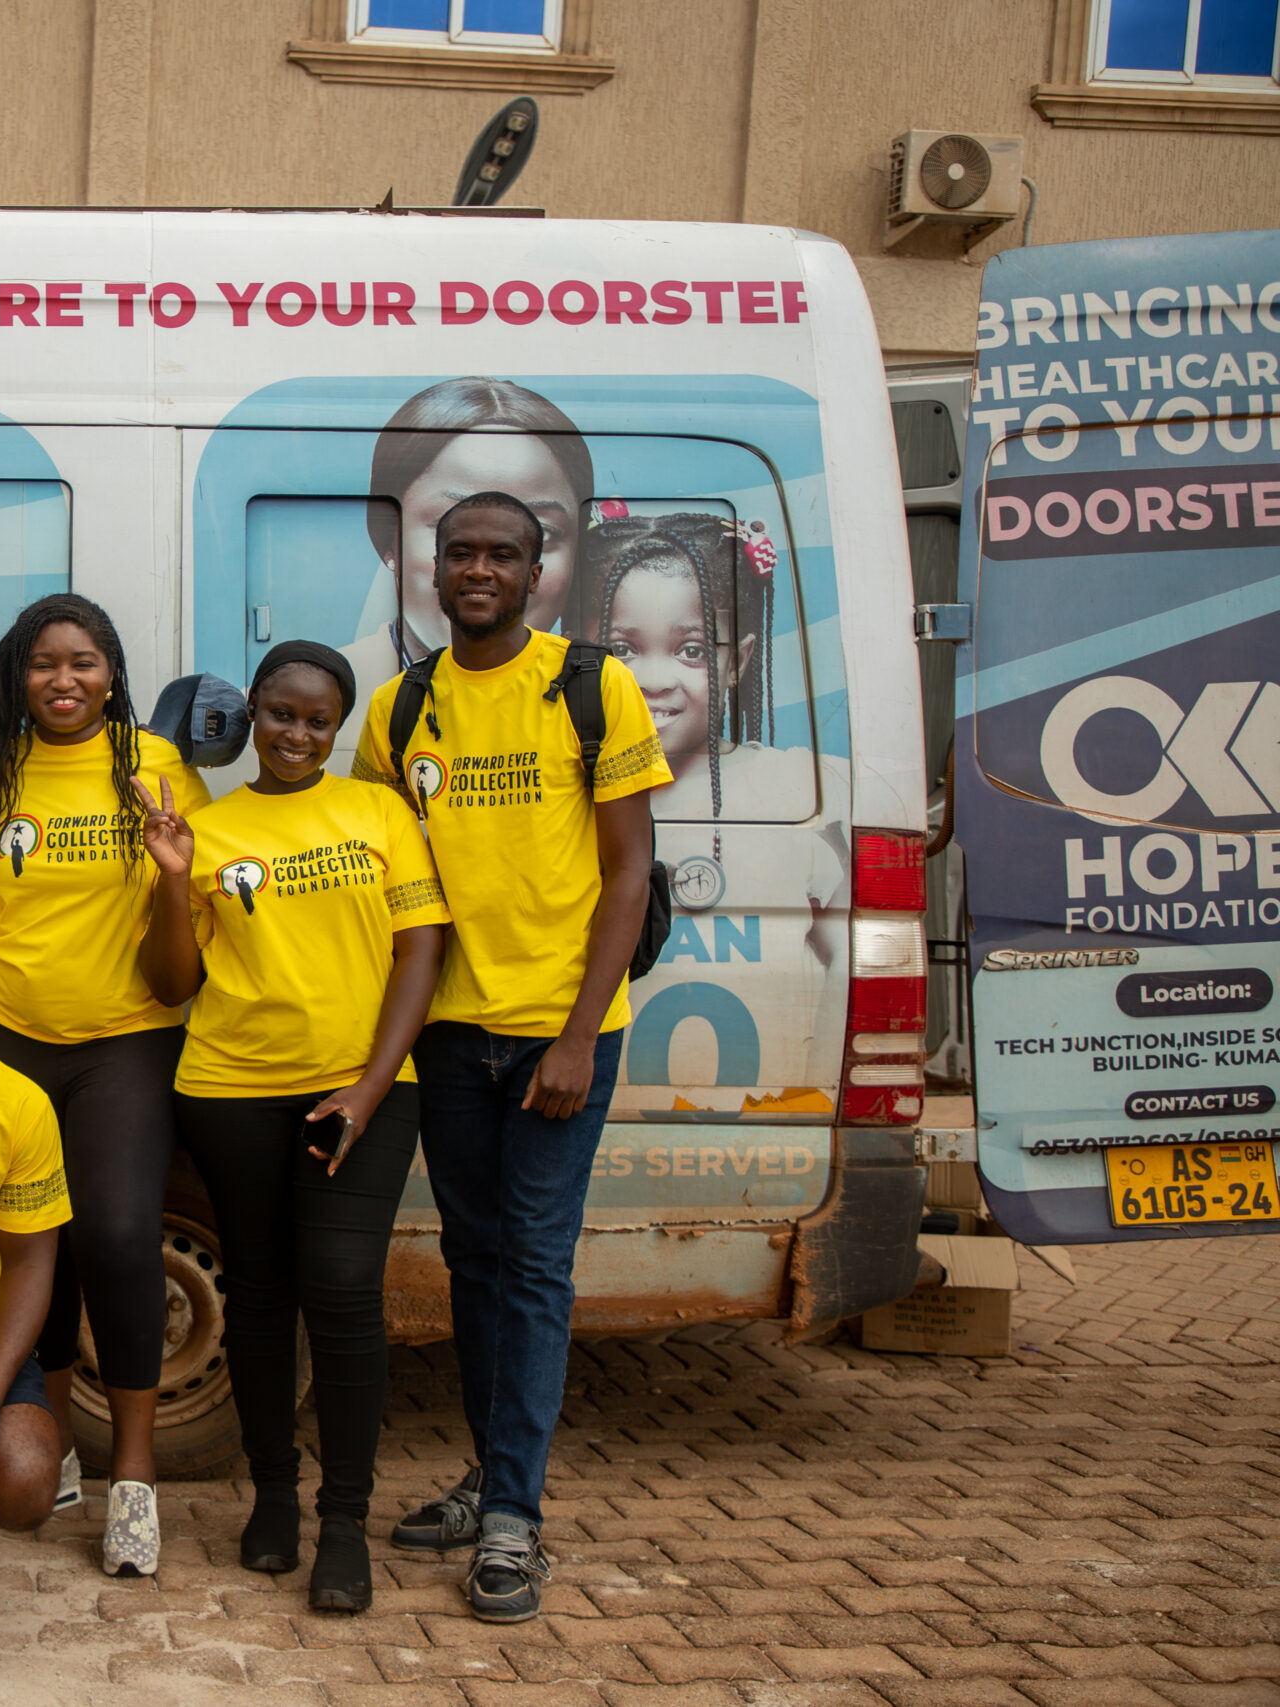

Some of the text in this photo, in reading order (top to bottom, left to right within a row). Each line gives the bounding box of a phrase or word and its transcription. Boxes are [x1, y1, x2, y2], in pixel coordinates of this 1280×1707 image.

[104, 281, 196, 328] TO
[216, 280, 417, 327] YOUR
[973, 393, 1280, 466] TO YOU
[451, 751, 538, 772] FORWARD EVER
[450, 769, 541, 792] COLLECTIVE
[449, 791, 542, 808] FOUNDATION
[47, 814, 107, 830] FORWARD
[272, 839, 368, 867] FORWARD EVER
[274, 852, 372, 883] COLLECTIVE
[277, 873, 375, 898] FOUNDATION
[982, 949, 1138, 971] SPRINTER
[1140, 980, 1252, 1004] Location:
[995, 1037, 1055, 1056] TECH
[1093, 1052, 1208, 1072] BUILDING-
[1130, 1092, 1260, 1114] CONTACT US
[645, 1145, 816, 1178] SERVED
[1172, 1147, 1213, 1183] AS
[1245, 1145, 1266, 1162] GH
[1121, 1181, 1273, 1222] 6105-24
